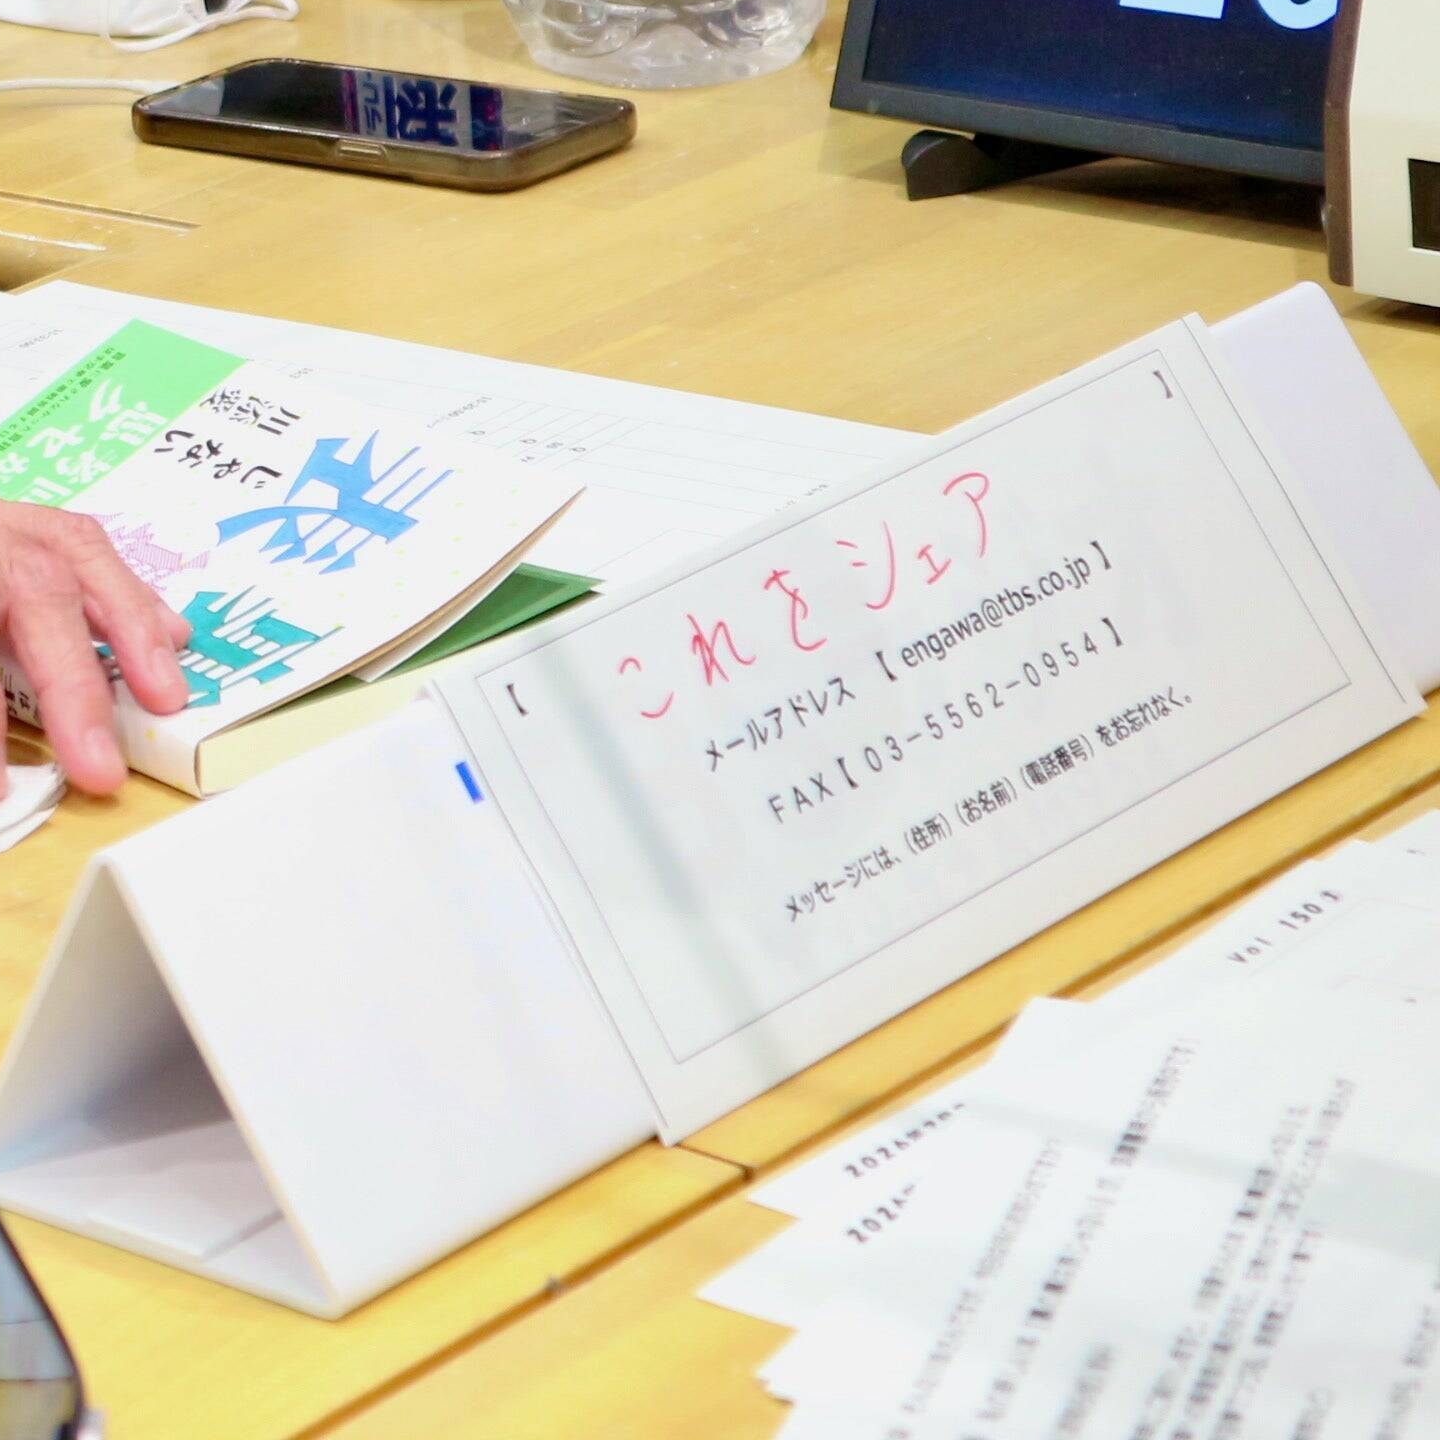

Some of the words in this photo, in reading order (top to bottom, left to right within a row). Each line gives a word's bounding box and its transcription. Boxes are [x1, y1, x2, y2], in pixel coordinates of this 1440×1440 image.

[706, 676, 856, 773] メールアドレス
